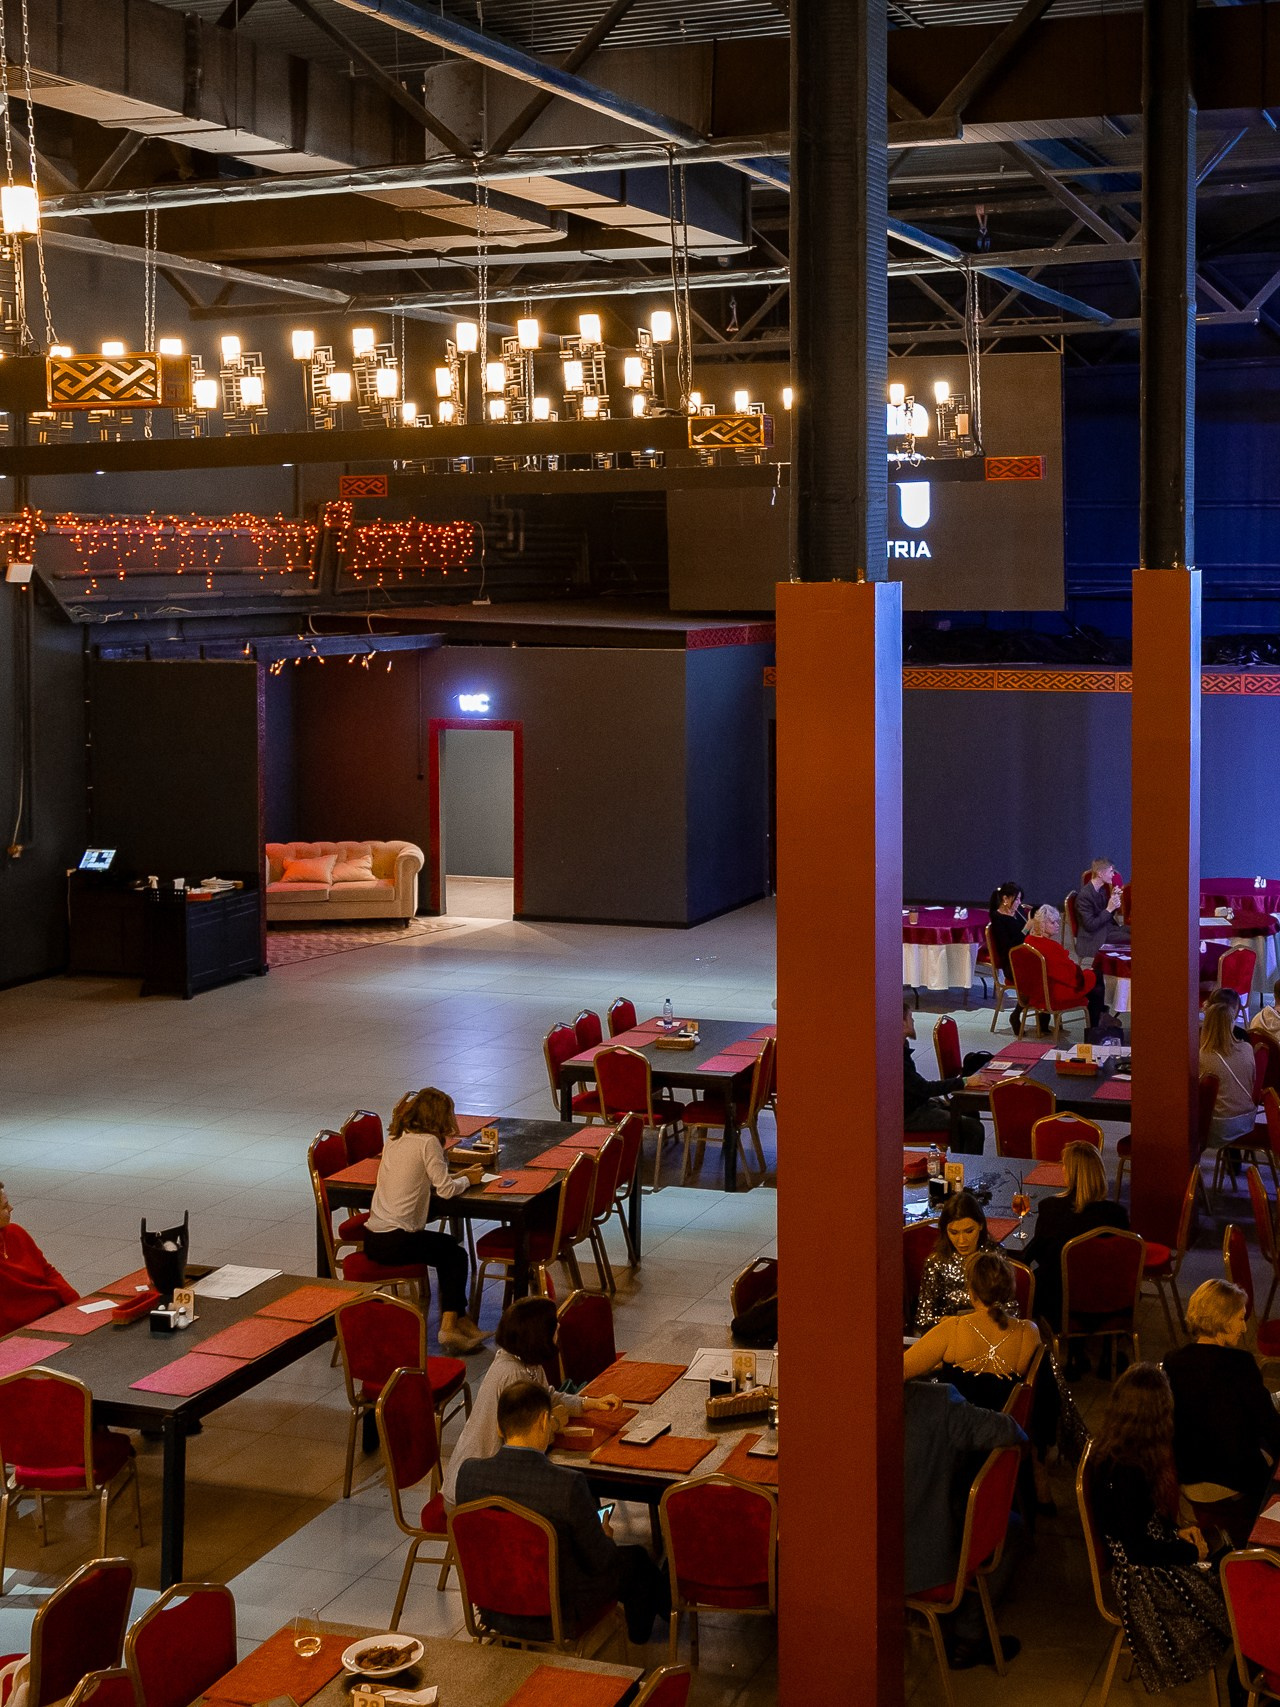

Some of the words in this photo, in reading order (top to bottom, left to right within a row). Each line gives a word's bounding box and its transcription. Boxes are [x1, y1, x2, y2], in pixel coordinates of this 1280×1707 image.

[483, 1130, 496, 1140] 59
[948, 1165, 961, 1174] 58
[175, 1292, 191, 1304] 49
[735, 1355, 752, 1368] 48
